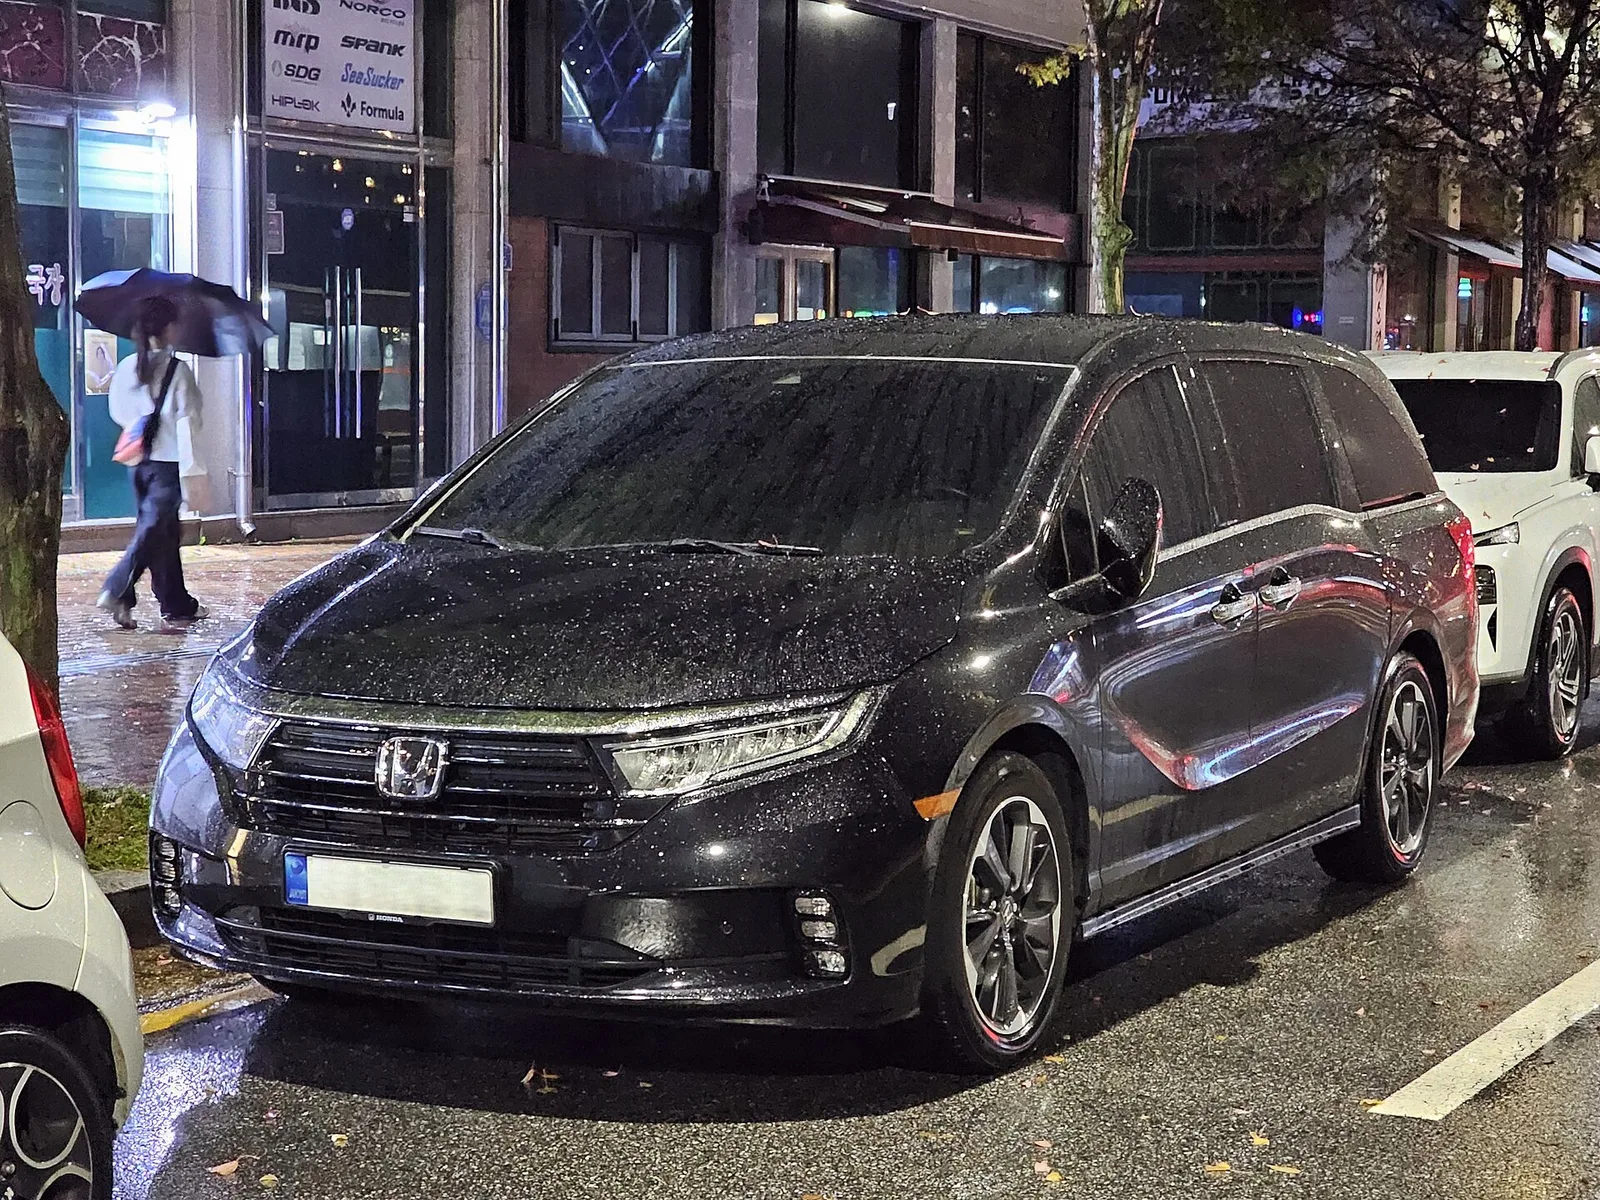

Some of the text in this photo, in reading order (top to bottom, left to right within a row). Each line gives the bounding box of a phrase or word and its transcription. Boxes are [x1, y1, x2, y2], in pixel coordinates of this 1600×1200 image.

[339, 0, 406, 19] NORCO
[284, 63, 321, 81] SDG
[341, 62, 404, 91] SeaSucker
[360, 101, 405, 121] Formula
[376, 914, 404, 923] HONDA
